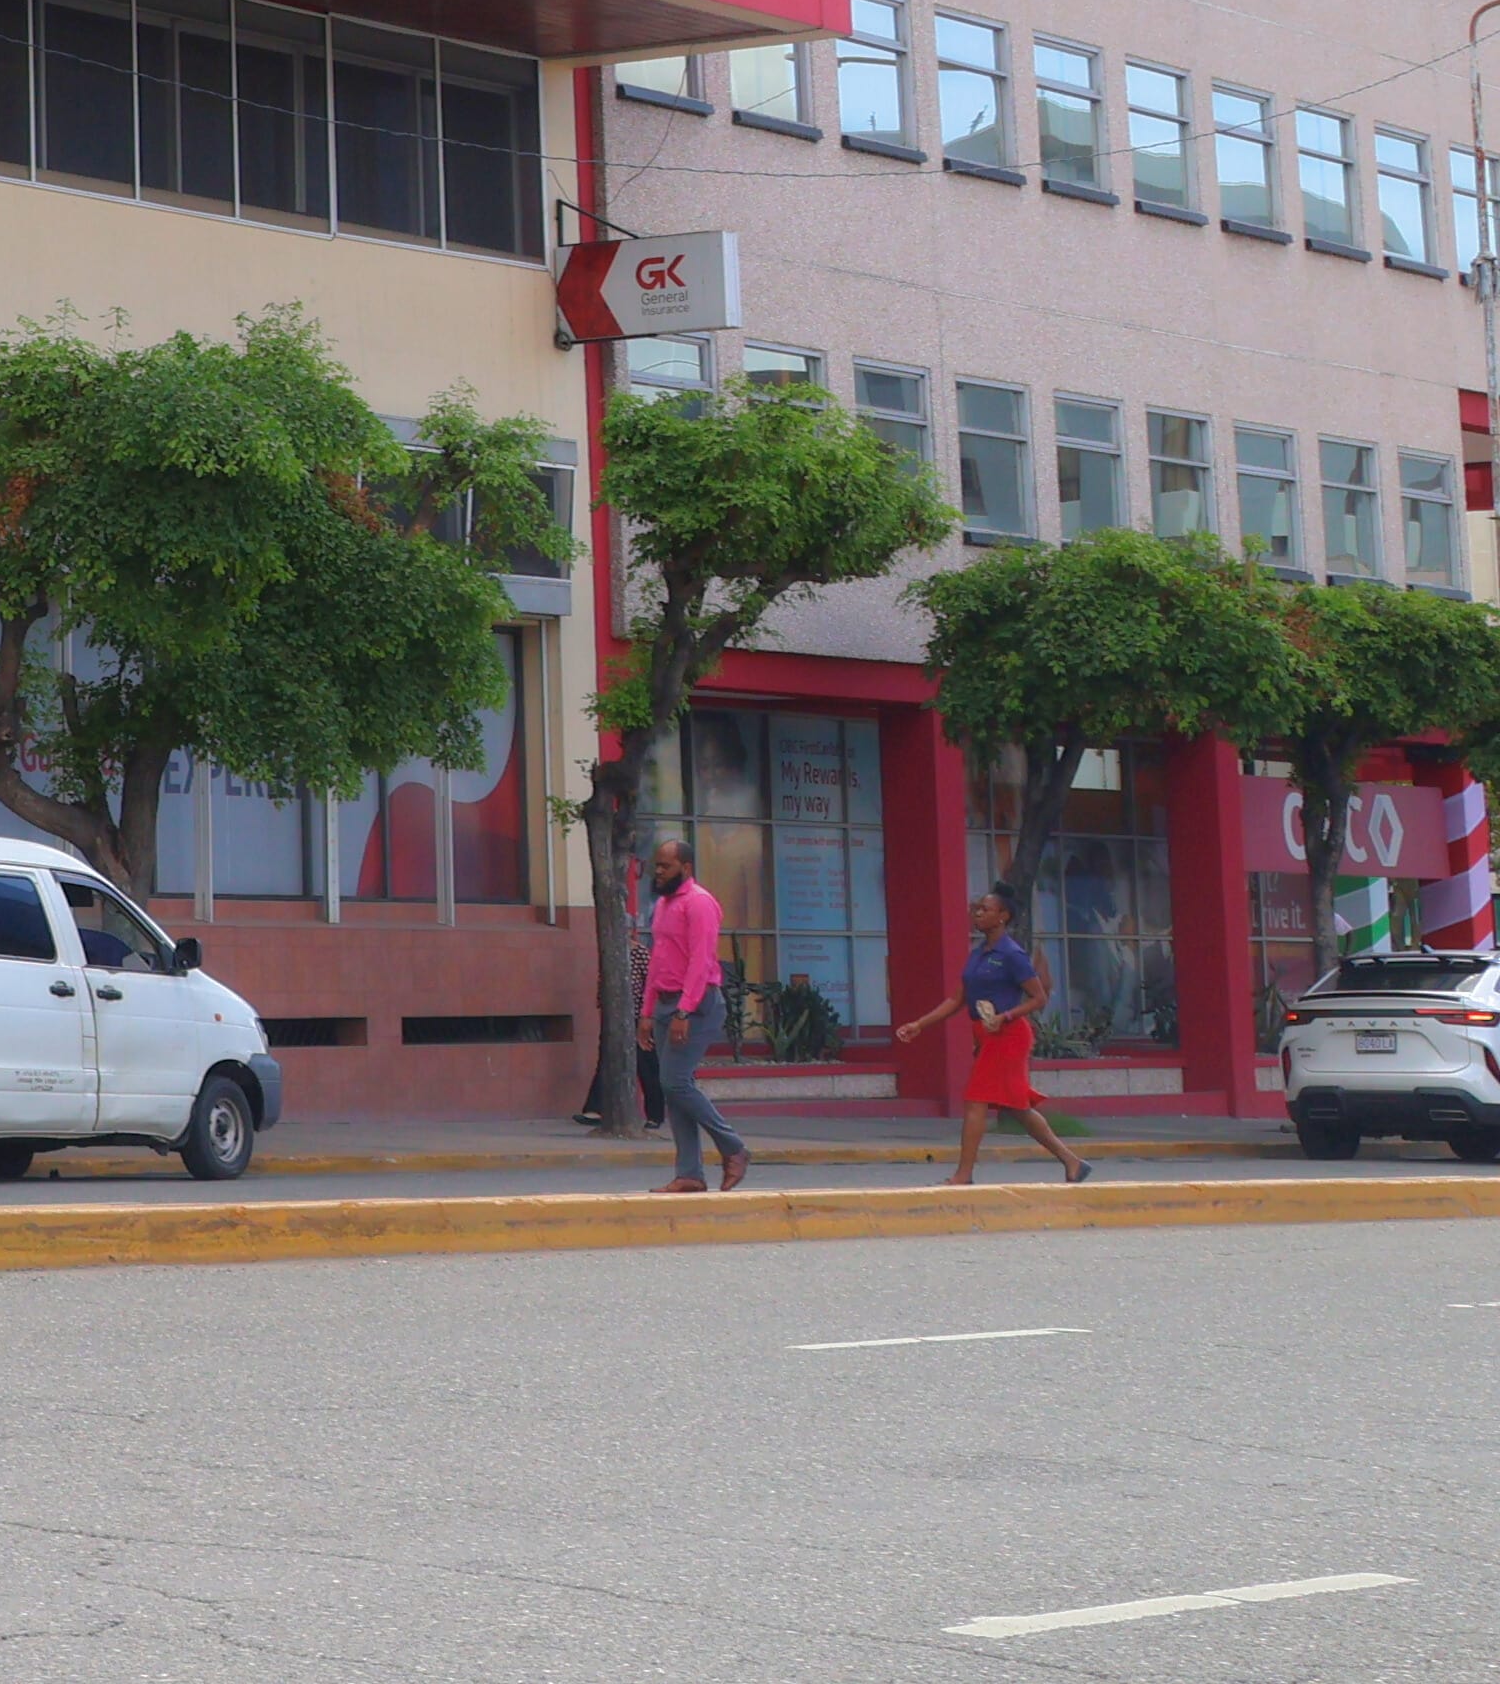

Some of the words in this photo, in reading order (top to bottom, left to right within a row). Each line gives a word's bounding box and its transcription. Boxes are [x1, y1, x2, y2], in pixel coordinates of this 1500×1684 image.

[635, 254, 687, 290] GK
[640, 290, 689, 306] General
[640, 302, 690, 317] Insurance
[781, 760, 800, 791] My
[782, 795, 800, 819] my
[804, 795, 831, 821] way
[1326, 1019, 1422, 1028] HAVAL
